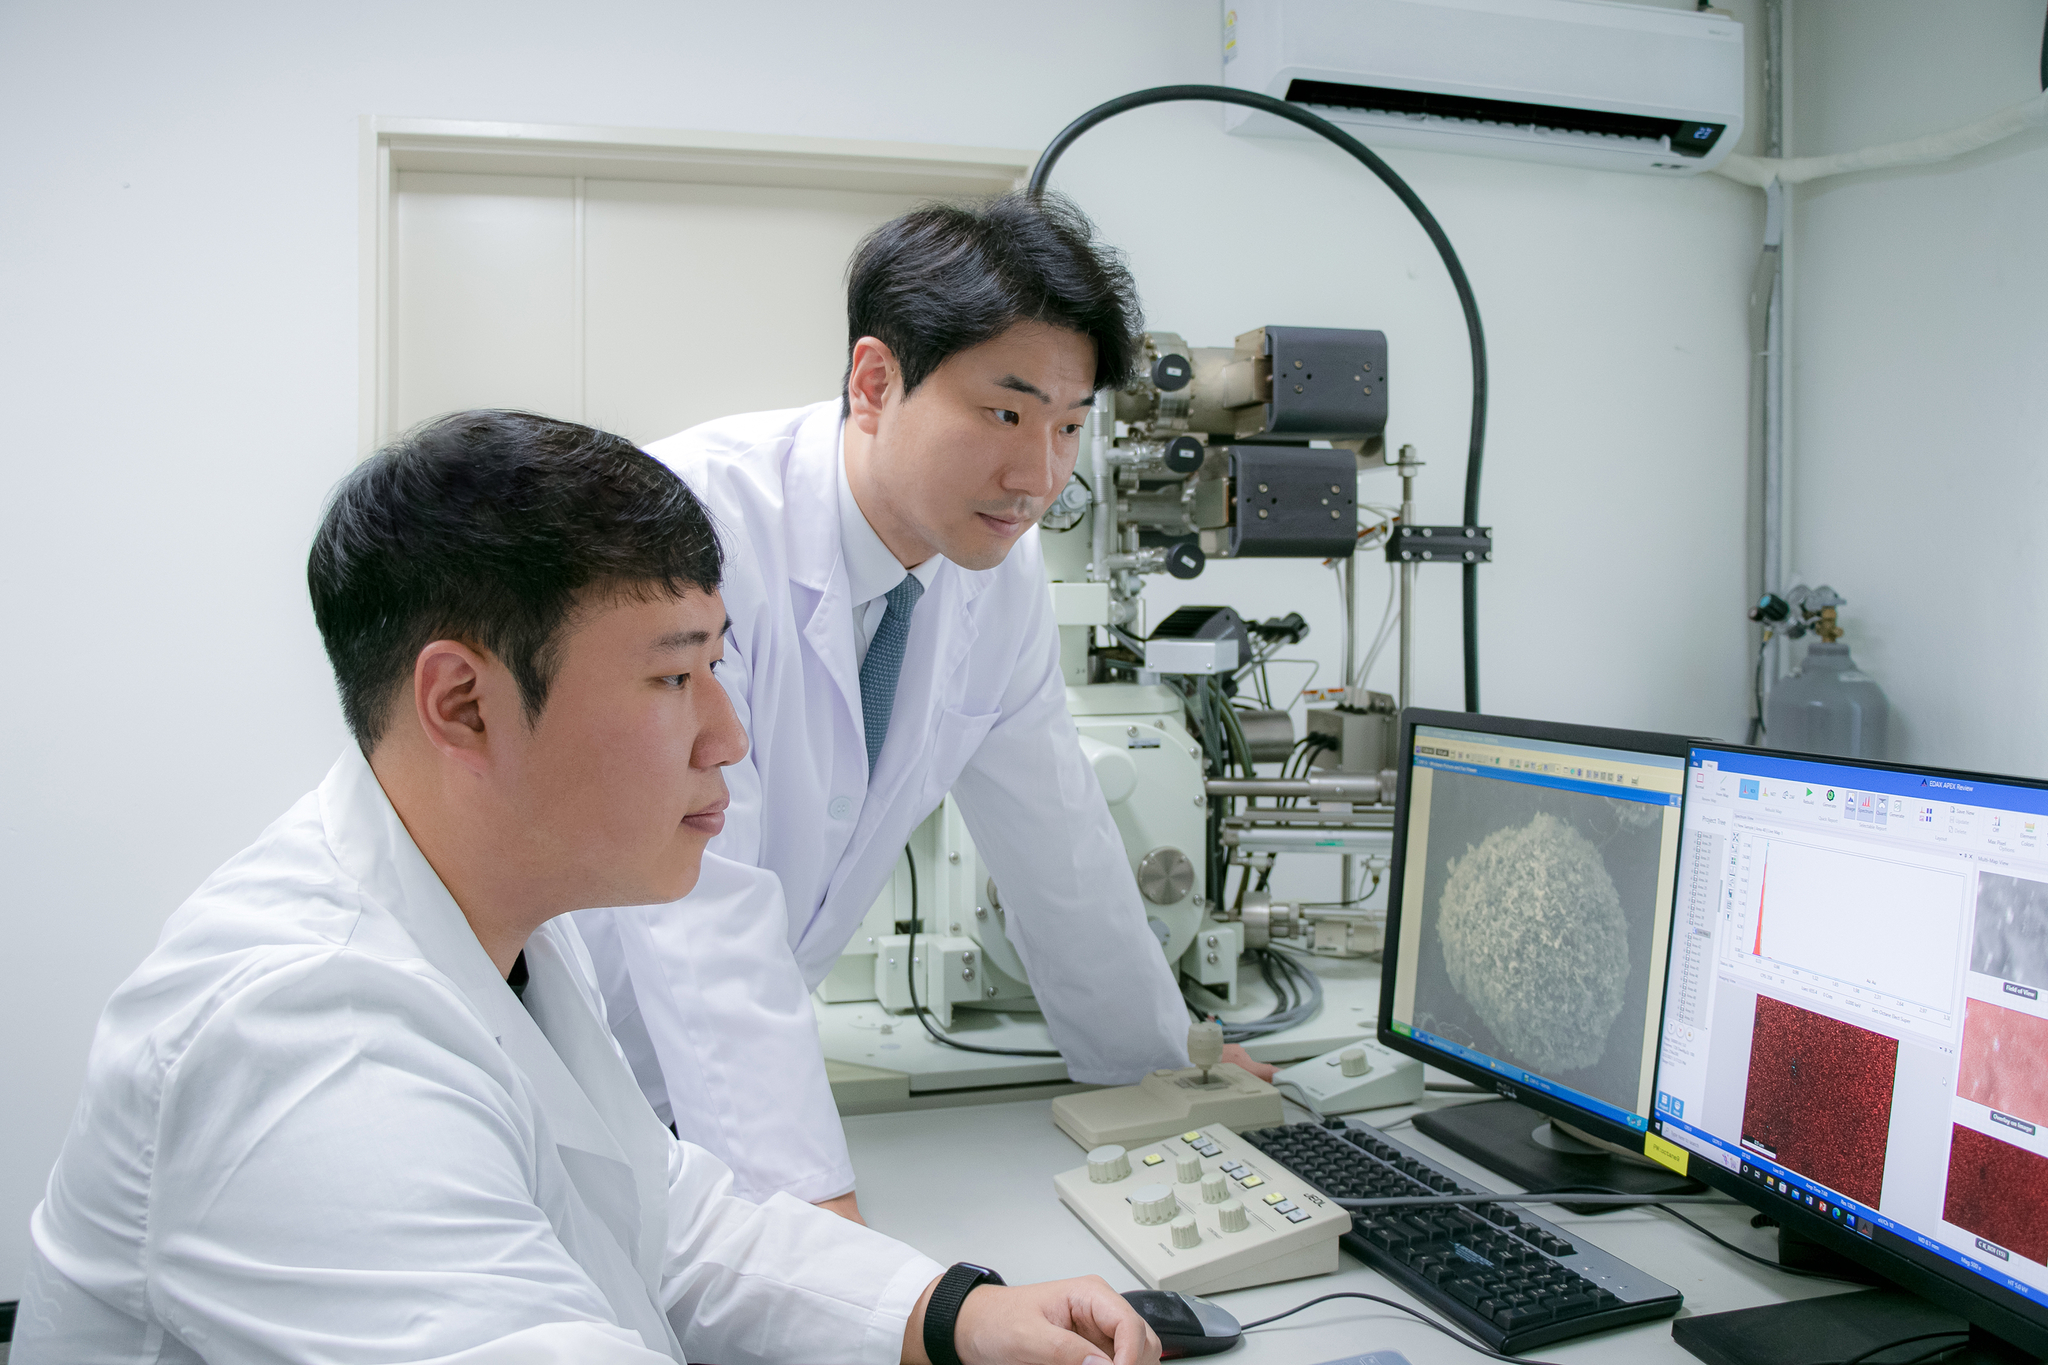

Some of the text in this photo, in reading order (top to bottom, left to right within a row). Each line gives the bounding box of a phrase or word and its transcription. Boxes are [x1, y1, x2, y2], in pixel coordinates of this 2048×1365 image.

[1930, 780, 1942, 788] EDAX
[1957, 783, 1973, 792] Review
[2006, 984, 2017, 993] Field
[2023, 989, 2035, 997] View
[1993, 1114, 2010, 1125] Overlay
[2018, 1122, 2032, 1132] Image
[1303, 1193, 1326, 1208] JEOL
